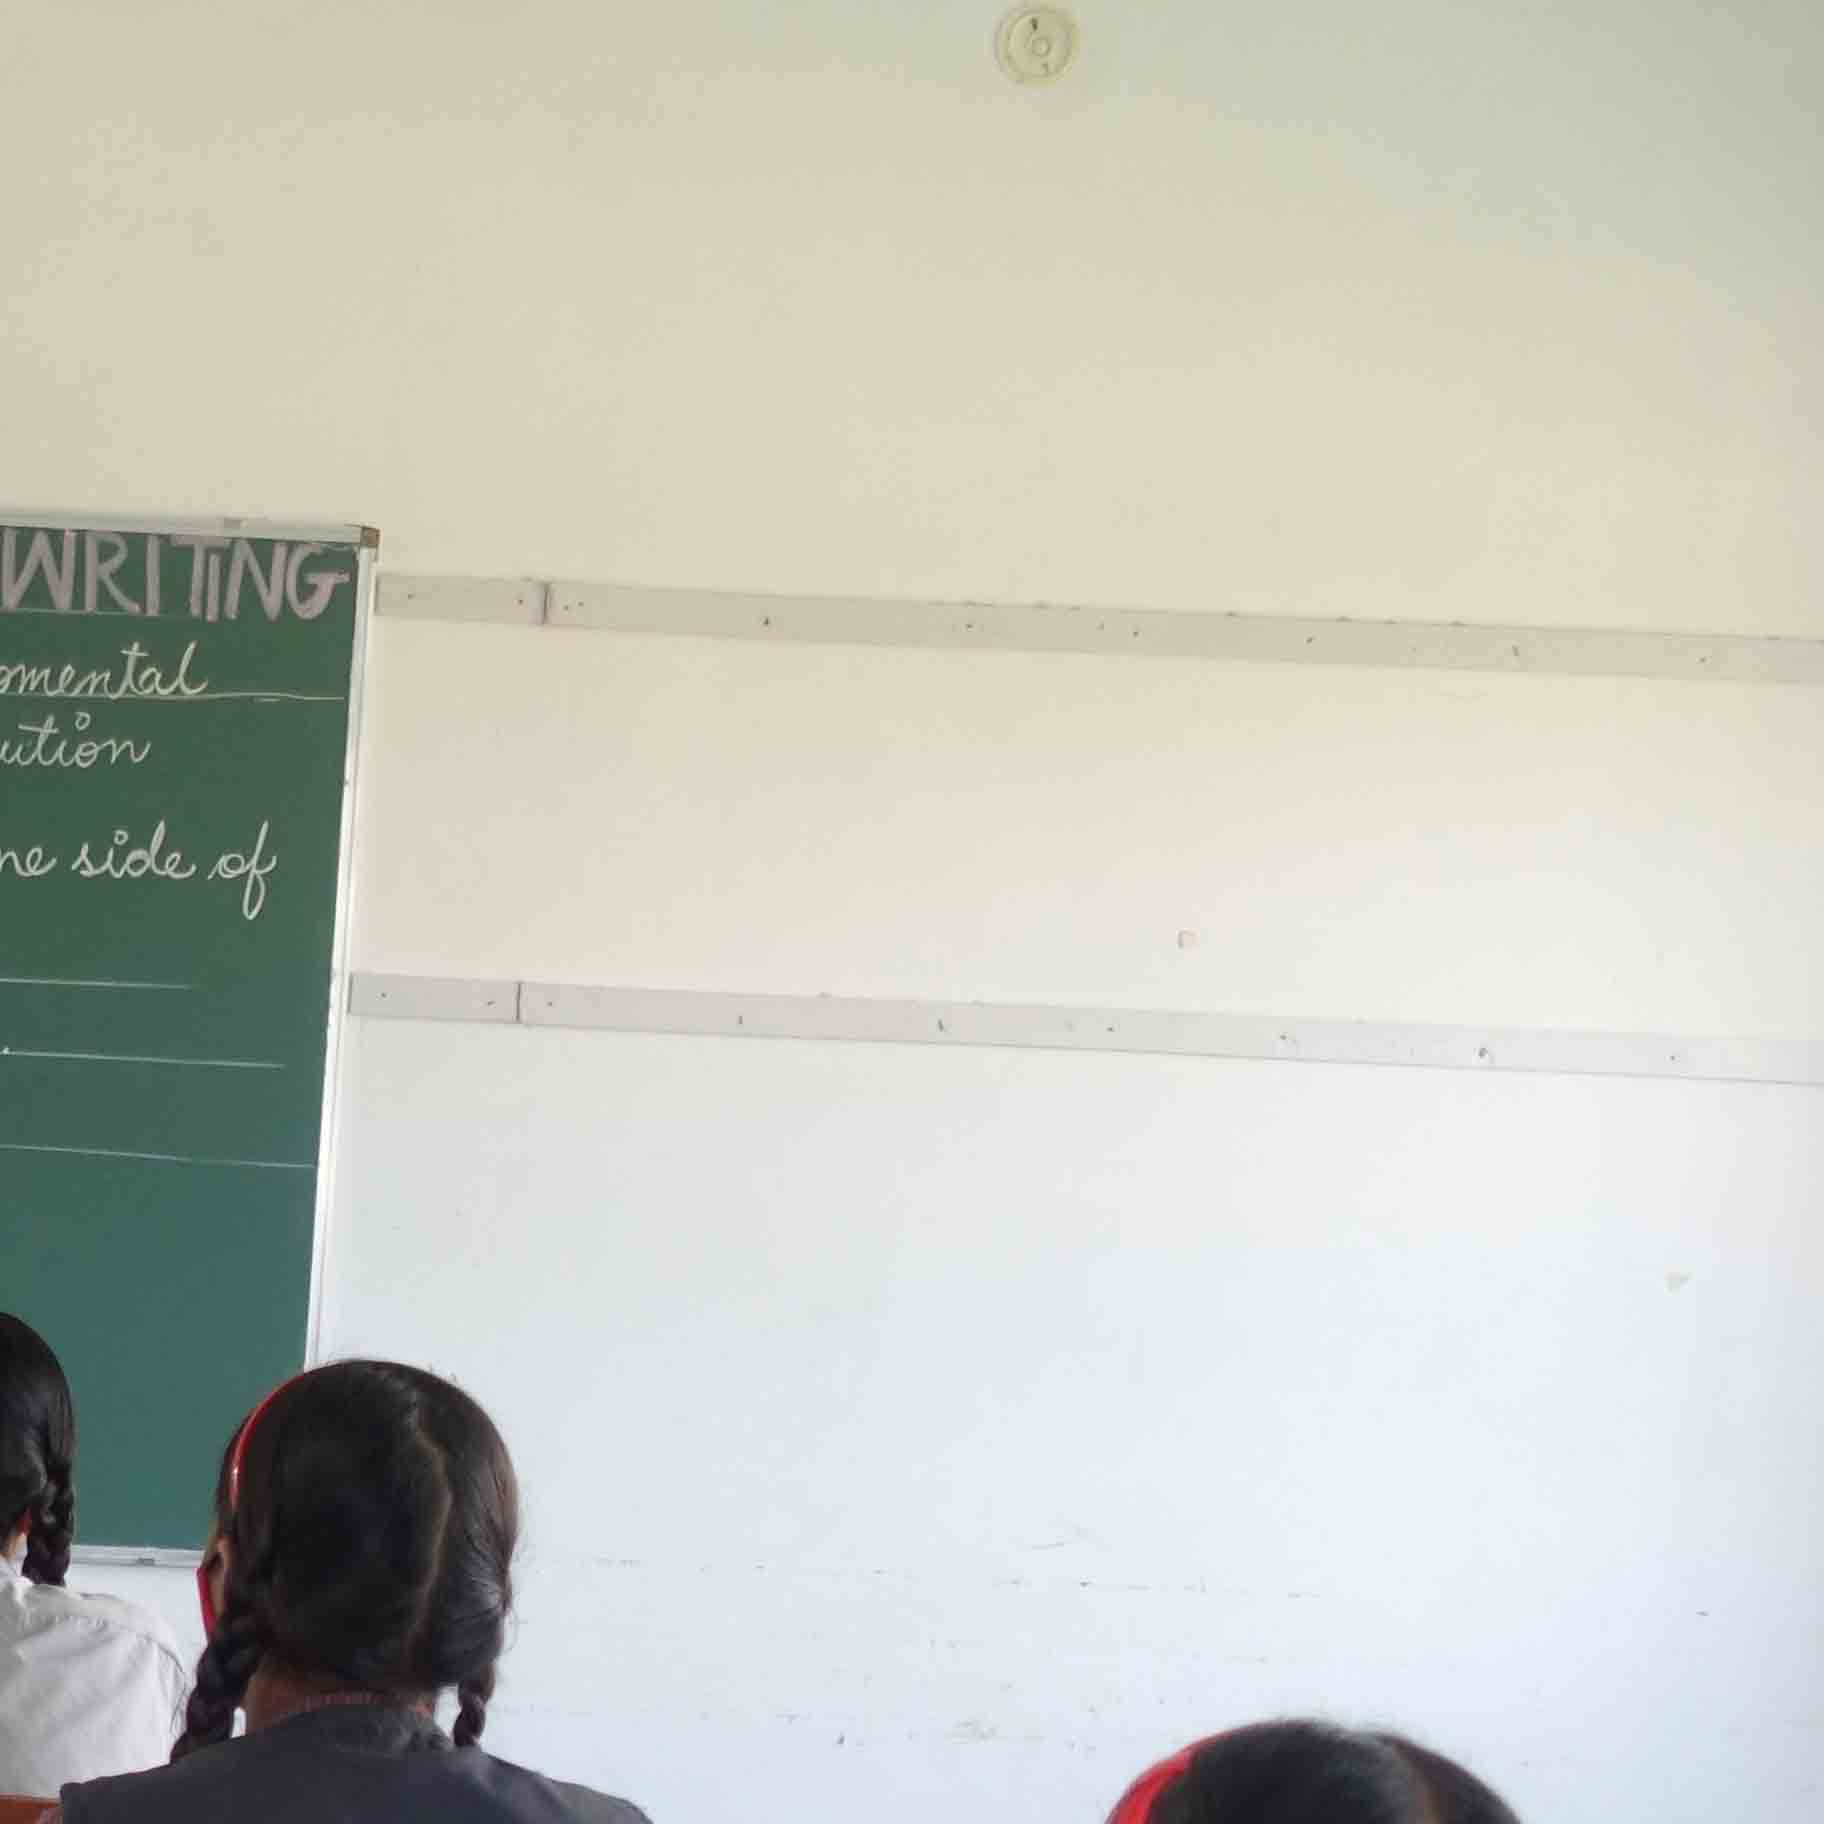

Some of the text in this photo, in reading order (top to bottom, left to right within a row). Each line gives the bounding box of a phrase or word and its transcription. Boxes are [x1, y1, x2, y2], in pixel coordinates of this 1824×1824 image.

[0, 526, 349, 621] WRITING
[71, 819, 196, 881] side
[207, 819, 278, 921] of
